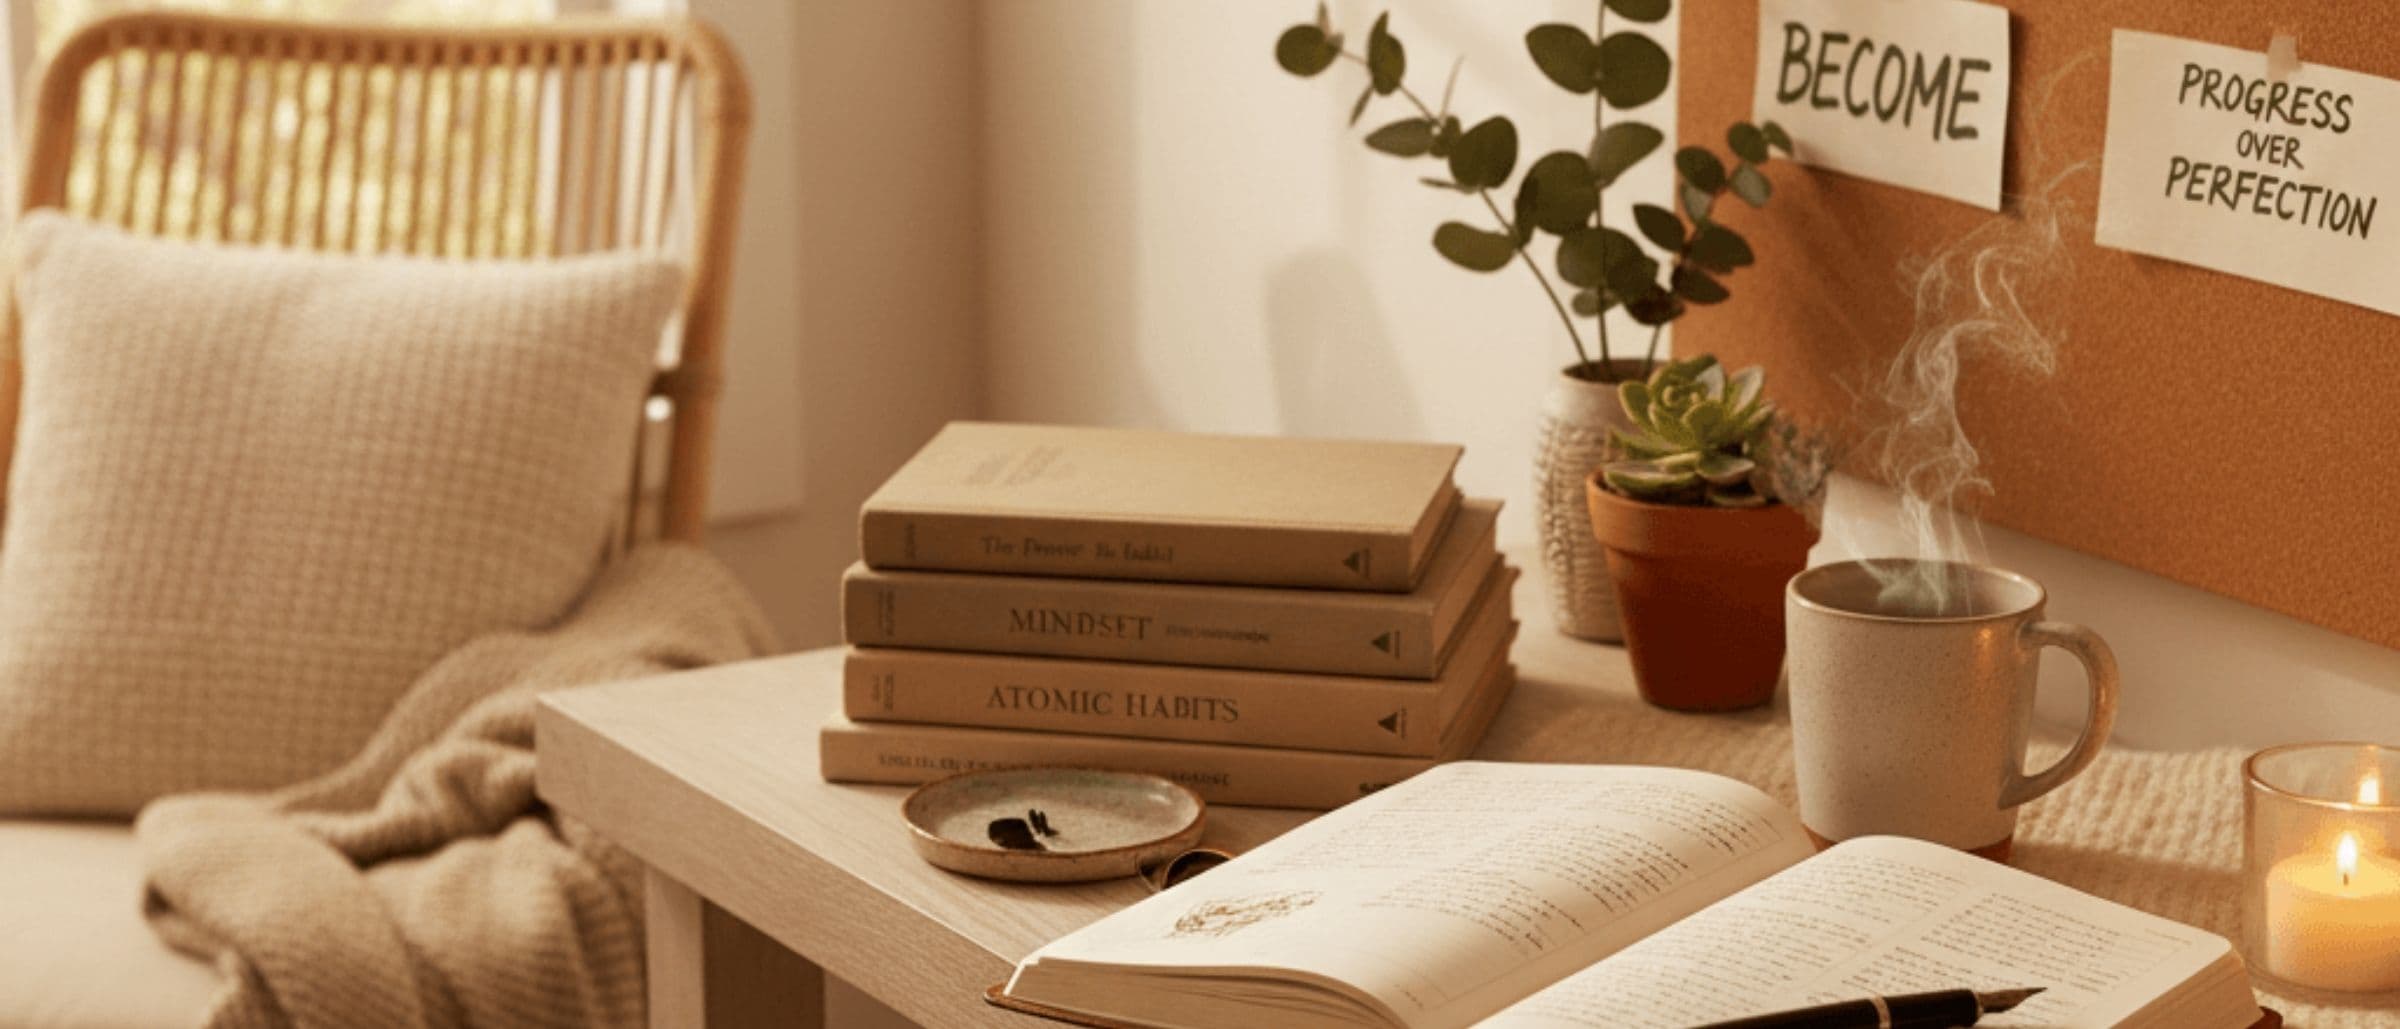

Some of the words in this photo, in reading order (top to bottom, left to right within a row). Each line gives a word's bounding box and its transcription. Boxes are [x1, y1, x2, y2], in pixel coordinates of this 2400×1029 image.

[1777, 21, 1992, 142] BECOME
[2179, 62, 2354, 134] PROGRESS
[2236, 129, 2305, 170] OVER
[2165, 155, 2378, 240] PERFECTION
[1008, 607, 1153, 641] MINDSET
[986, 684, 1114, 716] ATOMIC
[1125, 692, 1240, 724] HABITS
